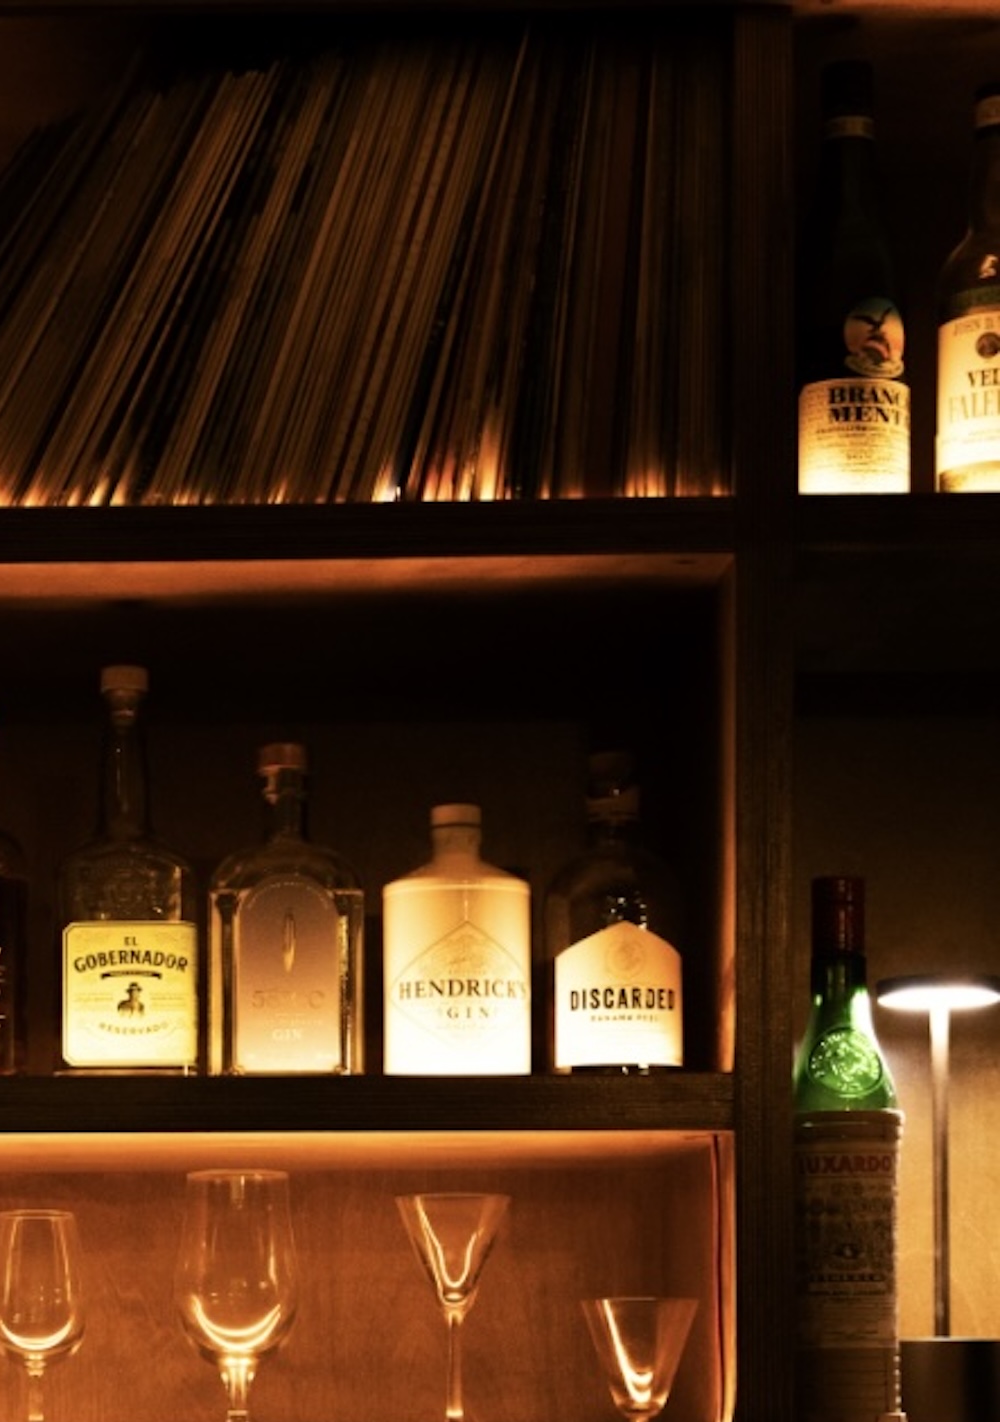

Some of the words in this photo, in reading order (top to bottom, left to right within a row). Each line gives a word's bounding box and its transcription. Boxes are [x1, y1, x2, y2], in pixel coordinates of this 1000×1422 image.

[123, 935, 139, 947] EL
[73, 948, 188, 974] GOBERNADOR
[570, 987, 675, 1011] DISCARDED
[446, 1006, 489, 1019] GIN
